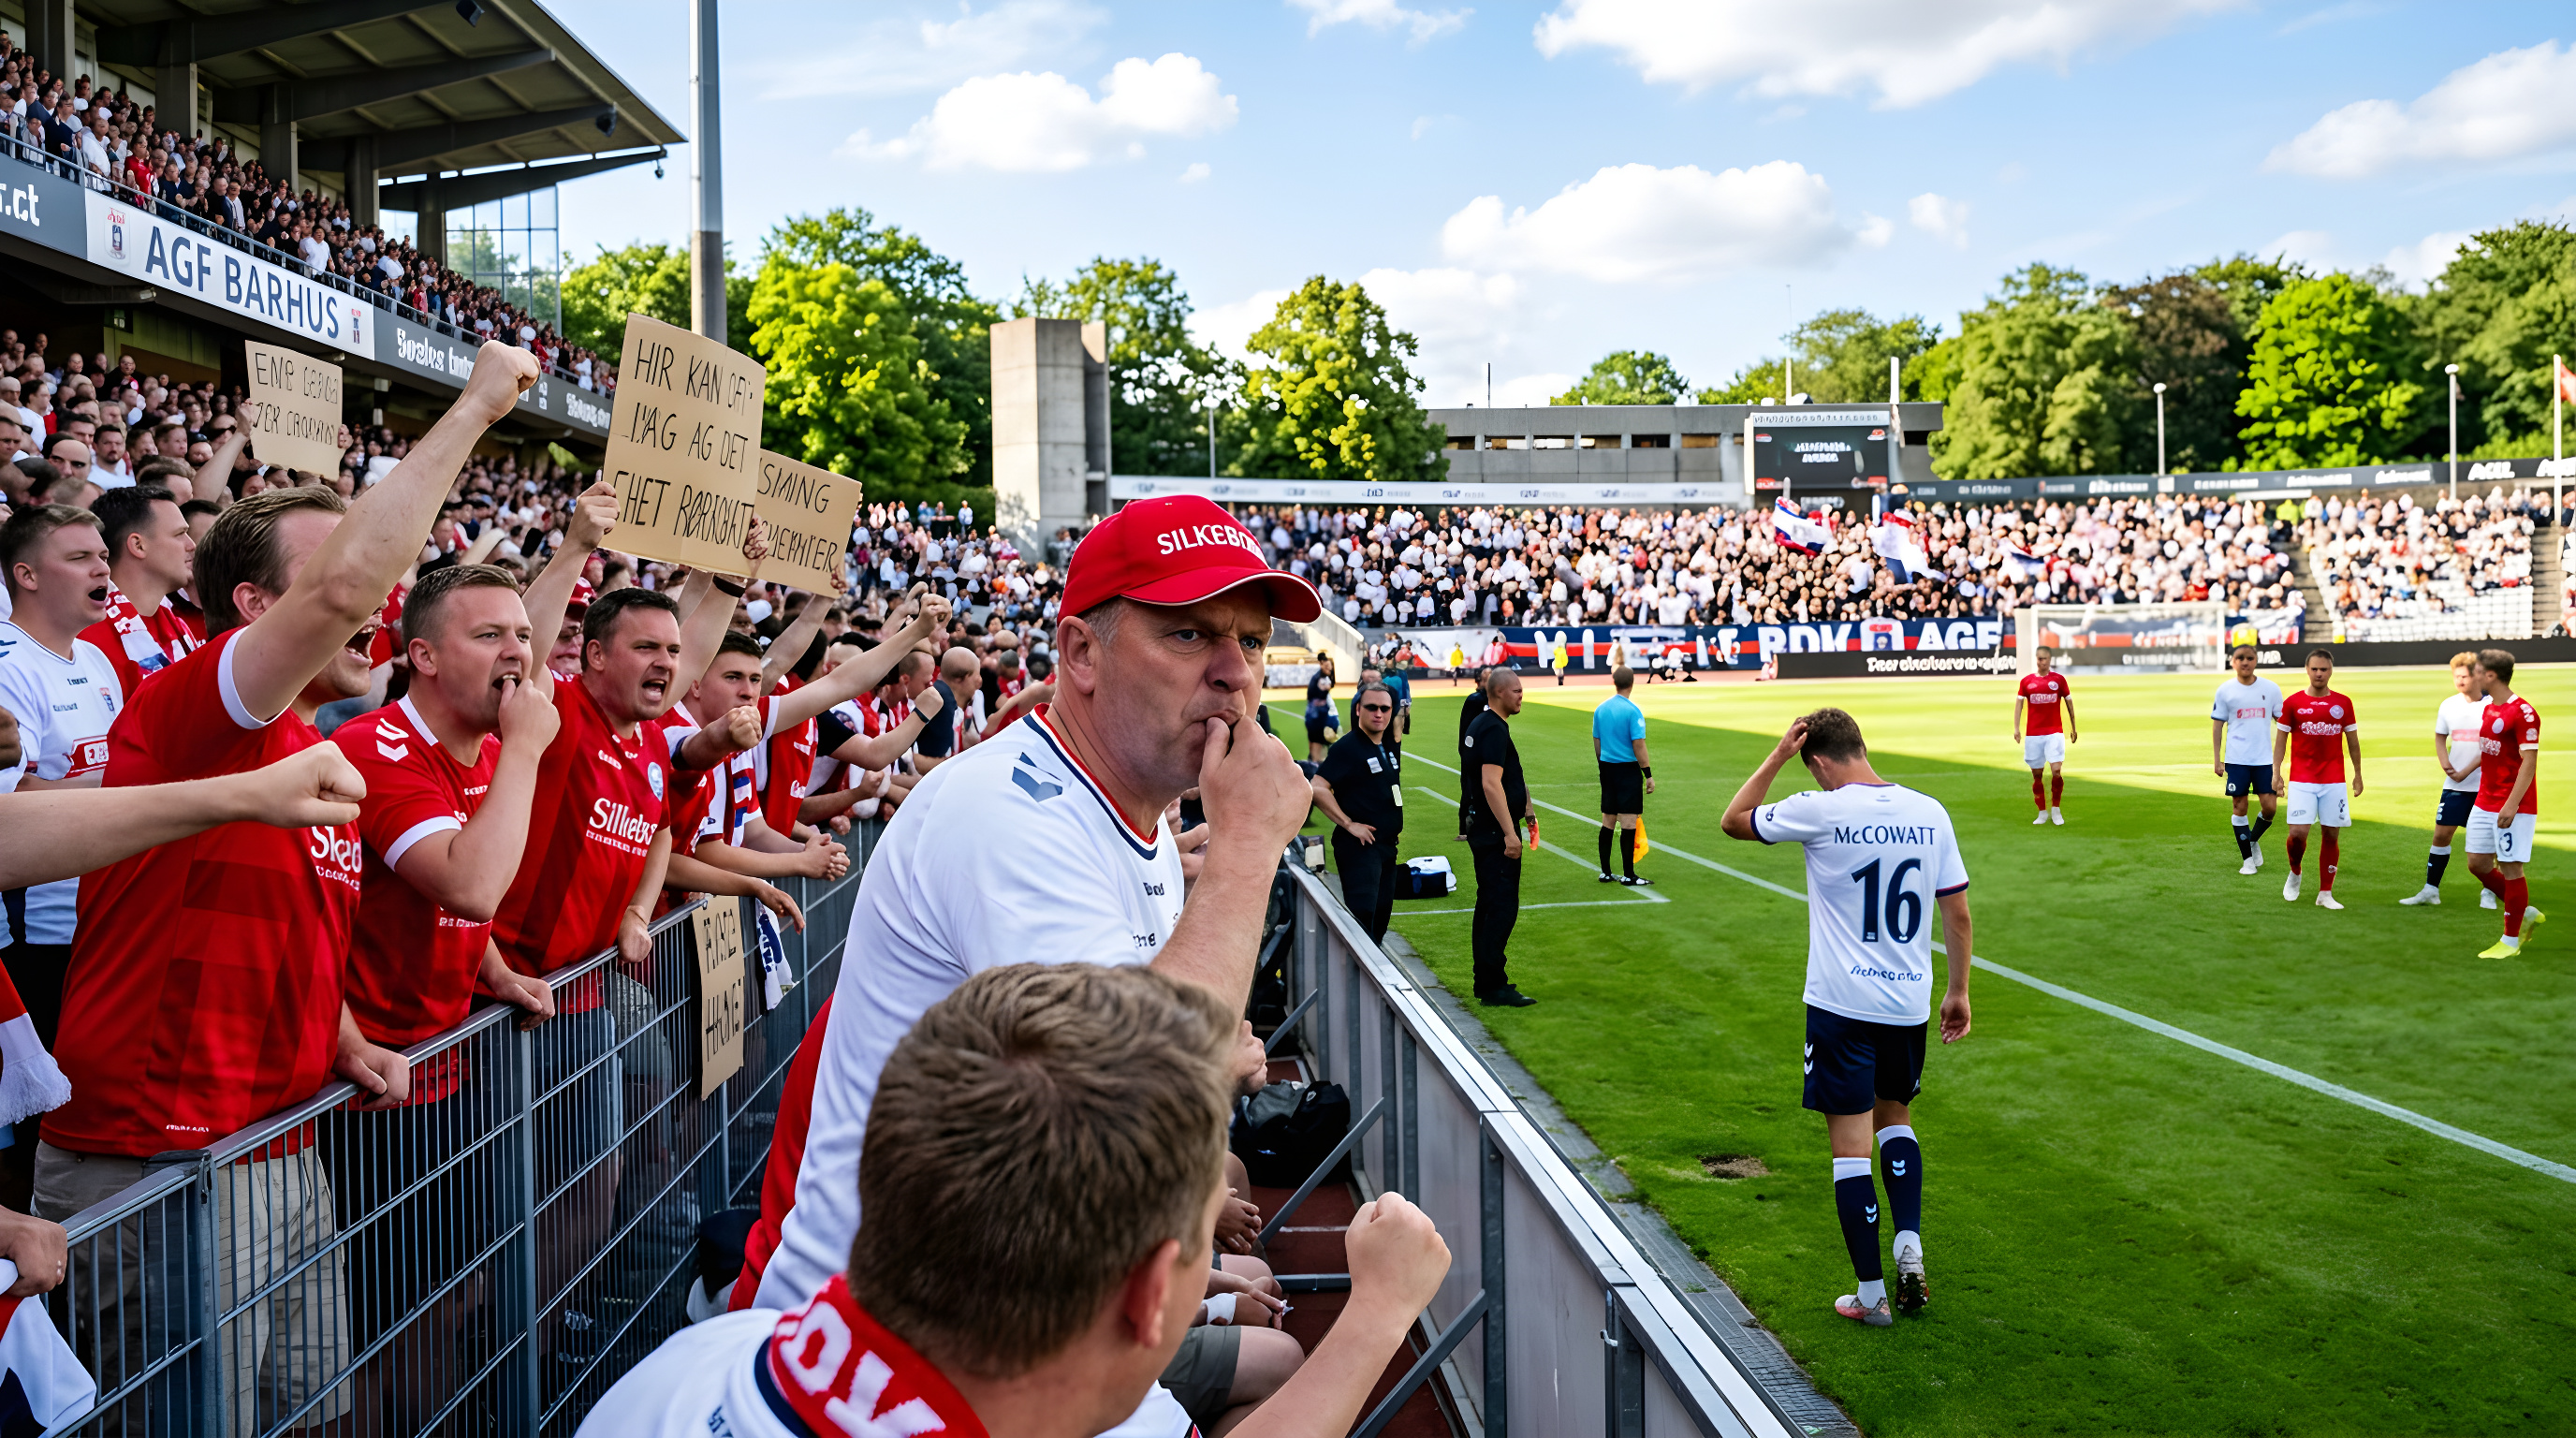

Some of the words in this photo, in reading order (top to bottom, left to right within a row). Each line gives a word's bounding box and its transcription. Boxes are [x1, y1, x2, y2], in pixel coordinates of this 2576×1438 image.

[145, 226, 212, 292] AGF
[225, 254, 339, 339] BARHUS
[685, 355, 724, 405] KAN
[688, 421, 714, 462] AG
[1834, 825, 1935, 845] McCOWATT
[1851, 857, 1922, 945] 16
